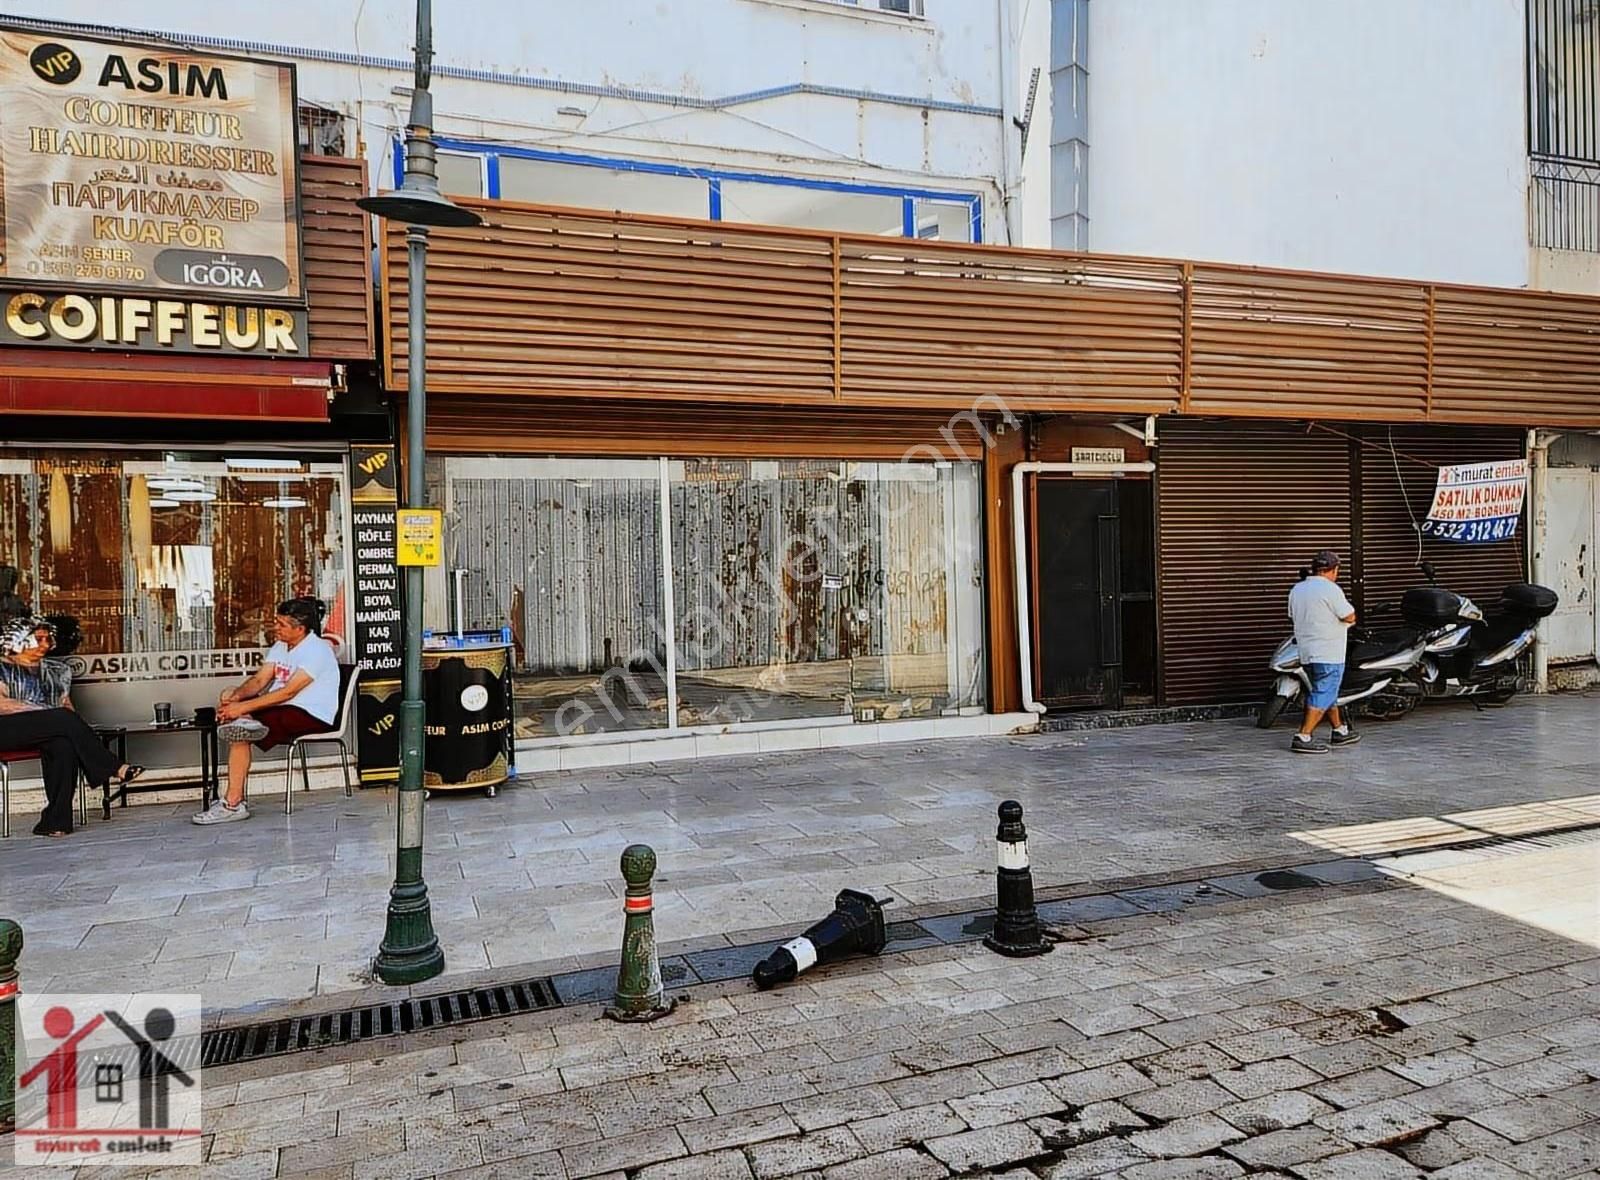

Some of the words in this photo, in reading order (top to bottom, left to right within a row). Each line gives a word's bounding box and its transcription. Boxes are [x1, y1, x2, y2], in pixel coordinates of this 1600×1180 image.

[36, 51, 75, 77] VIP
[97, 54, 228, 100] ASIM
[64, 96, 243, 141] COIFFEUR
[29, 126, 277, 176] HAIRDRESSER
[52, 182, 260, 223] ПАРИКМАХЕР
[93, 215, 225, 250] KUAFÖR
[82, 246, 133, 263] ŞENER
[183, 263, 265, 289] IGORA
[5, 291, 300, 353] COIFFEUR
[359, 452, 389, 476] VIP
[1462, 467, 1493, 481] murat
[1437, 488, 1481, 507] SATILIK
[353, 512, 396, 526] KAYNAK
[357, 528, 393, 543] RÖFLE
[1421, 520, 1433, 532] 0
[1434, 523, 1467, 538] 532
[1467, 522, 1491, 540] 312
[357, 547, 395, 559] OMBRE
[357, 564, 395, 576] PERMA
[358, 578, 397, 592] BALYAJ
[363, 595, 393, 607] BOYA
[356, 609, 401, 623] MANİKÜR
[368, 626, 391, 639] KAŞ
[366, 641, 394, 654] BIYIK
[89, 657, 149, 674] ASIM
[158, 650, 264, 671] COIFFEUR
[369, 713, 396, 736] VIP
[461, 722, 490, 735] ASIM
